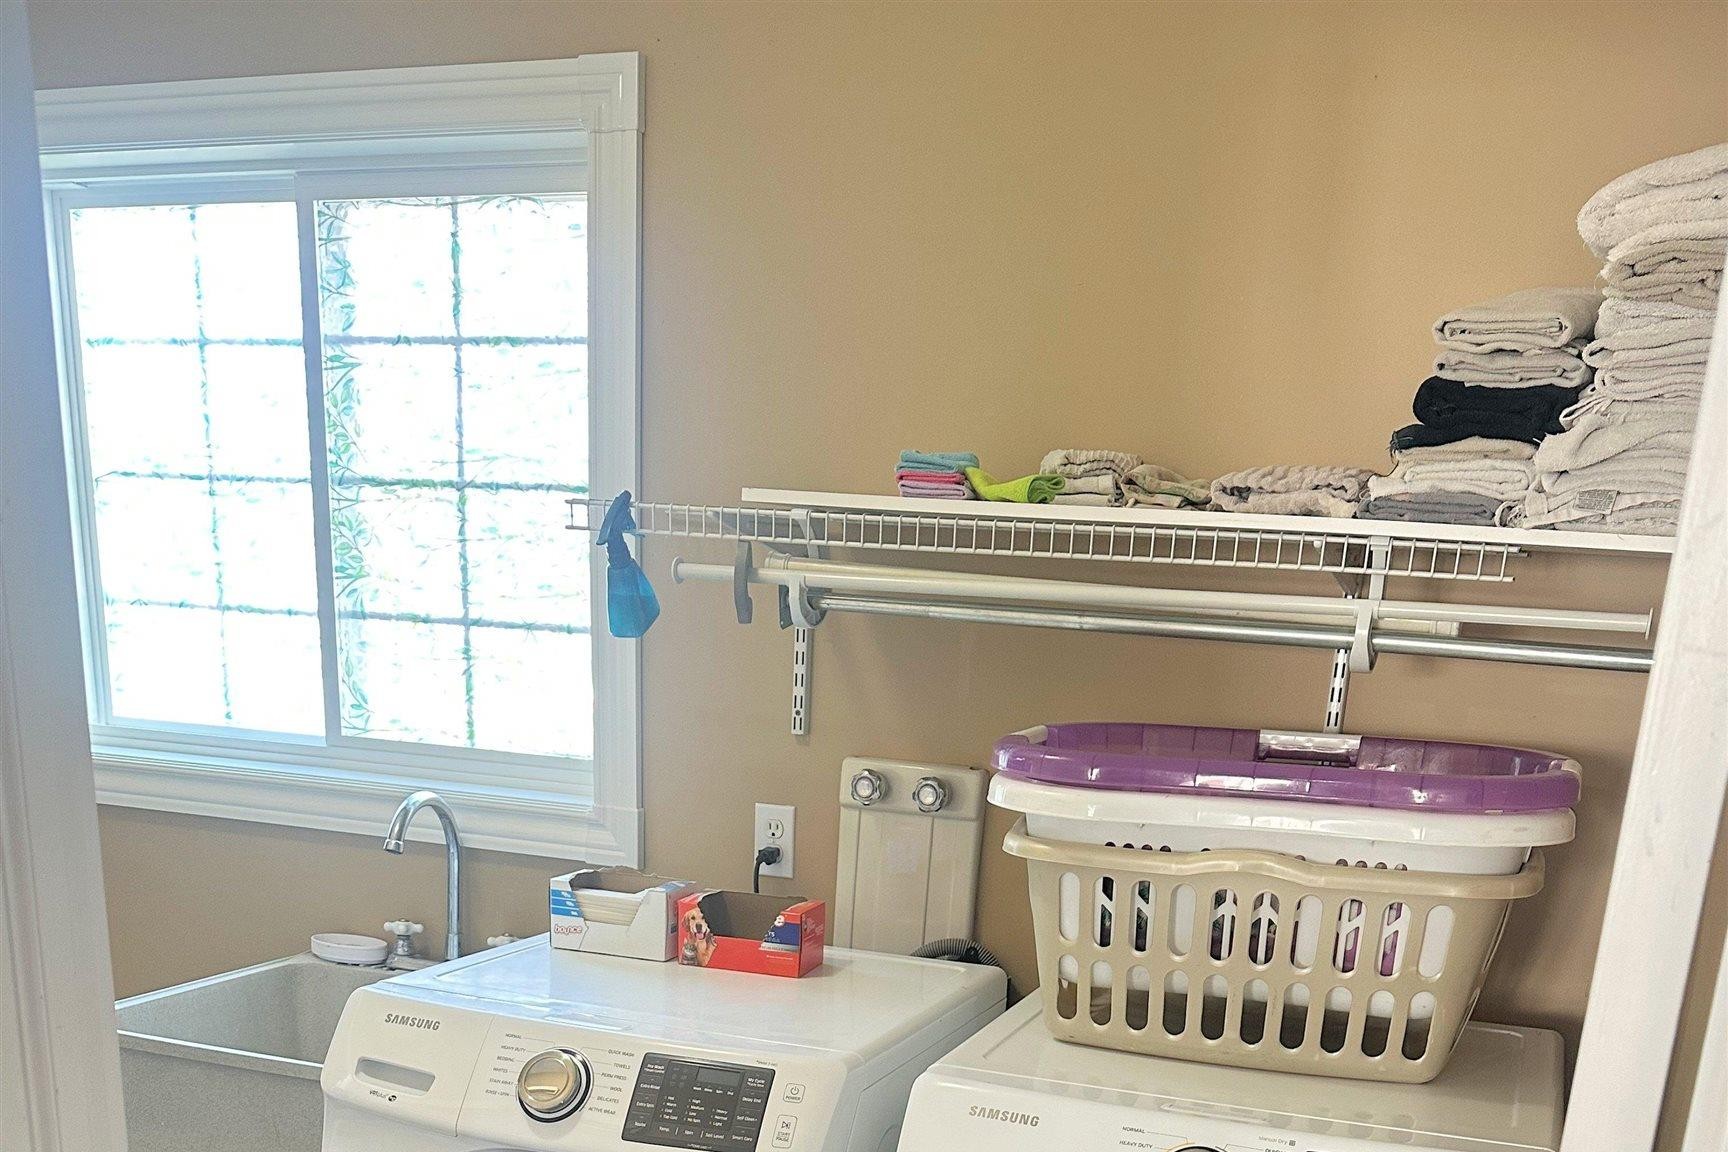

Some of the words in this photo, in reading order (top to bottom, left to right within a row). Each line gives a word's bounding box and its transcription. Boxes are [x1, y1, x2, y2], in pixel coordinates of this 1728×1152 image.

[554, 922, 583, 935] bounce
[384, 1013, 441, 1031] SAMSUNG
[968, 1105, 1040, 1127] SAMSUNG
[1122, 1126, 1146, 1134] NORMAL
